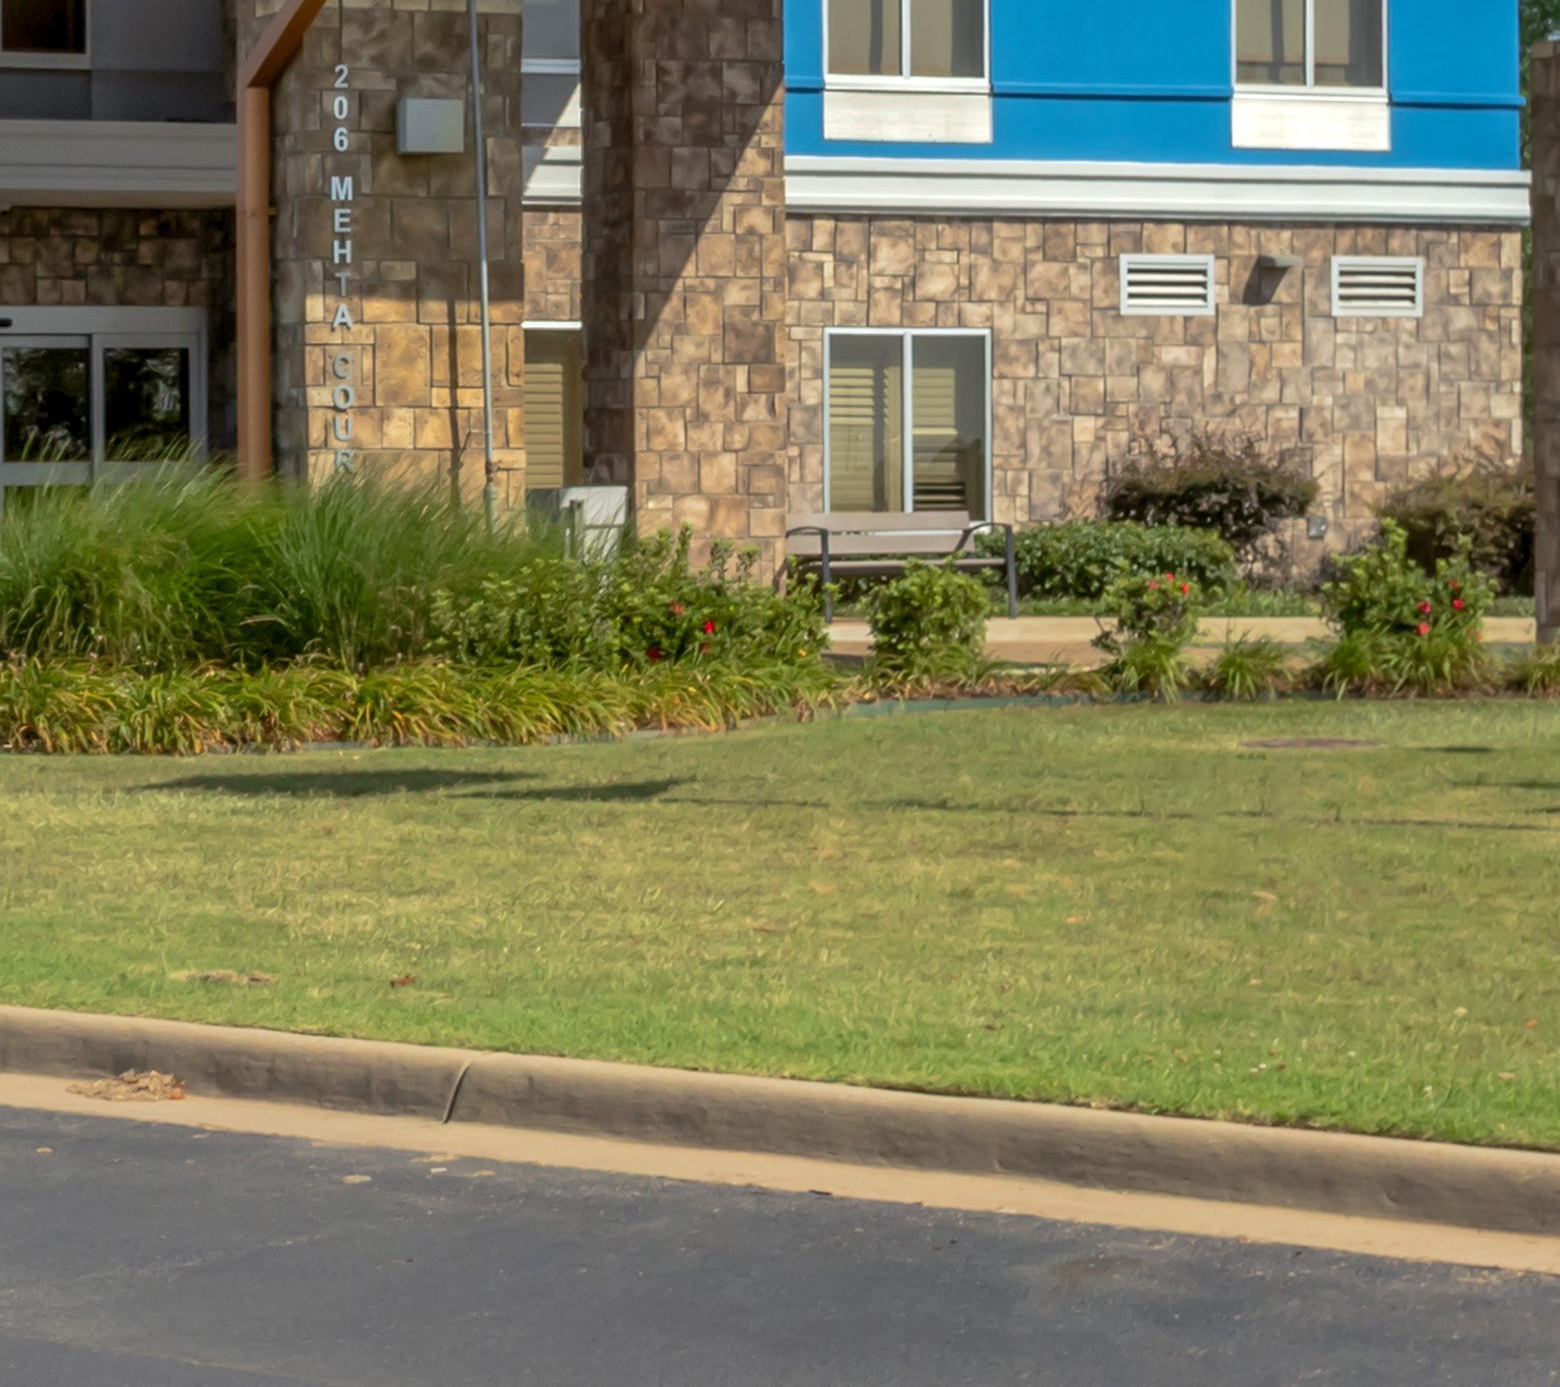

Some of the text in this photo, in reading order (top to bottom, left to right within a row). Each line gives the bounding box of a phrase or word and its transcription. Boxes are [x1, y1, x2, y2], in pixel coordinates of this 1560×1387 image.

[330, 64, 355, 473] 206 MEHTA COUR
